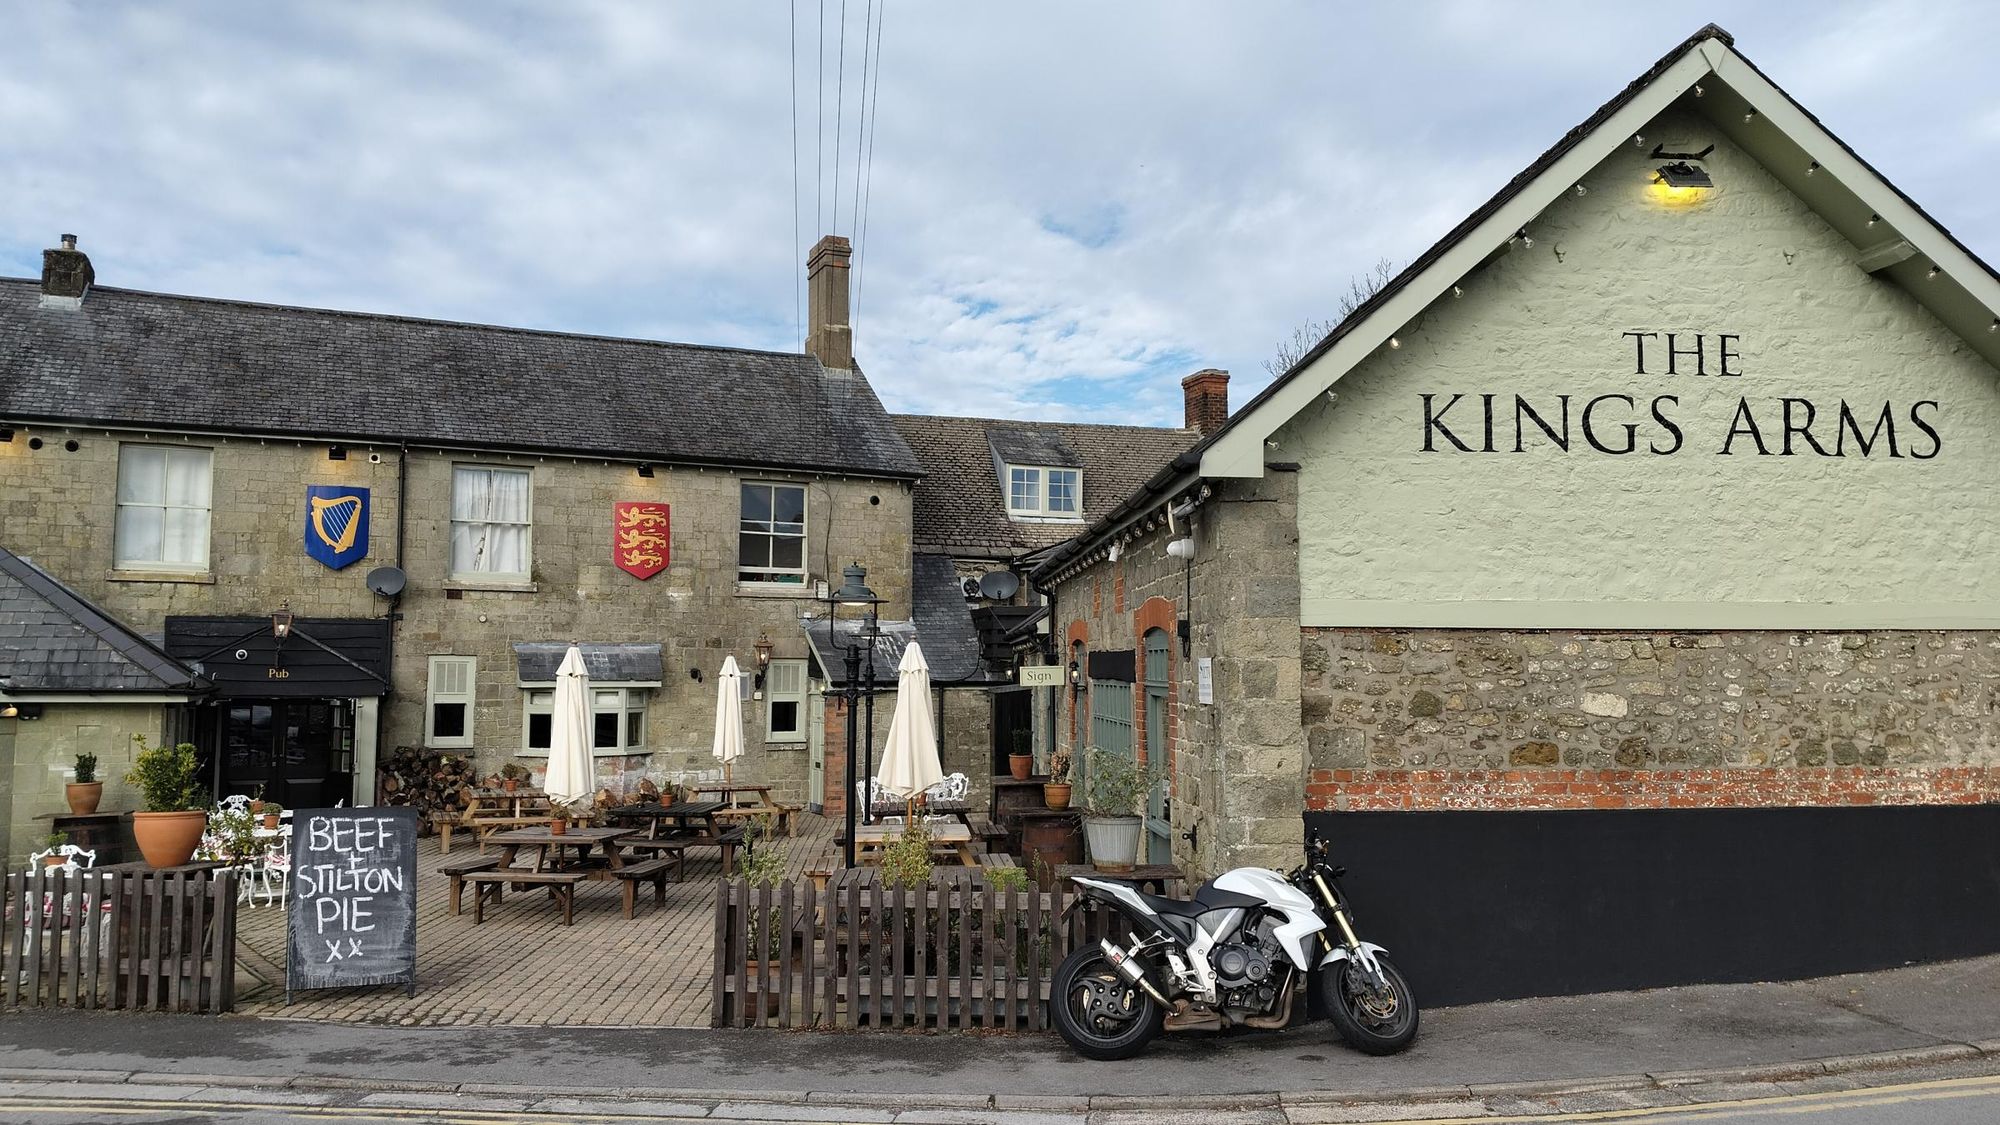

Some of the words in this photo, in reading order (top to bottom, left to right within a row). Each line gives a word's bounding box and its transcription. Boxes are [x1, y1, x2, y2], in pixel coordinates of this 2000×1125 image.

[1621, 331, 1743, 377] THE
[1417, 392, 1684, 456] KINGS
[1716, 396, 1942, 460] ARMS
[268, 668, 289, 678] Pub
[1027, 670, 1052, 683] Sign
[309, 816, 394, 852] BEEF
[297, 864, 403, 899] STILTON
[316, 896, 376, 934] PIE
